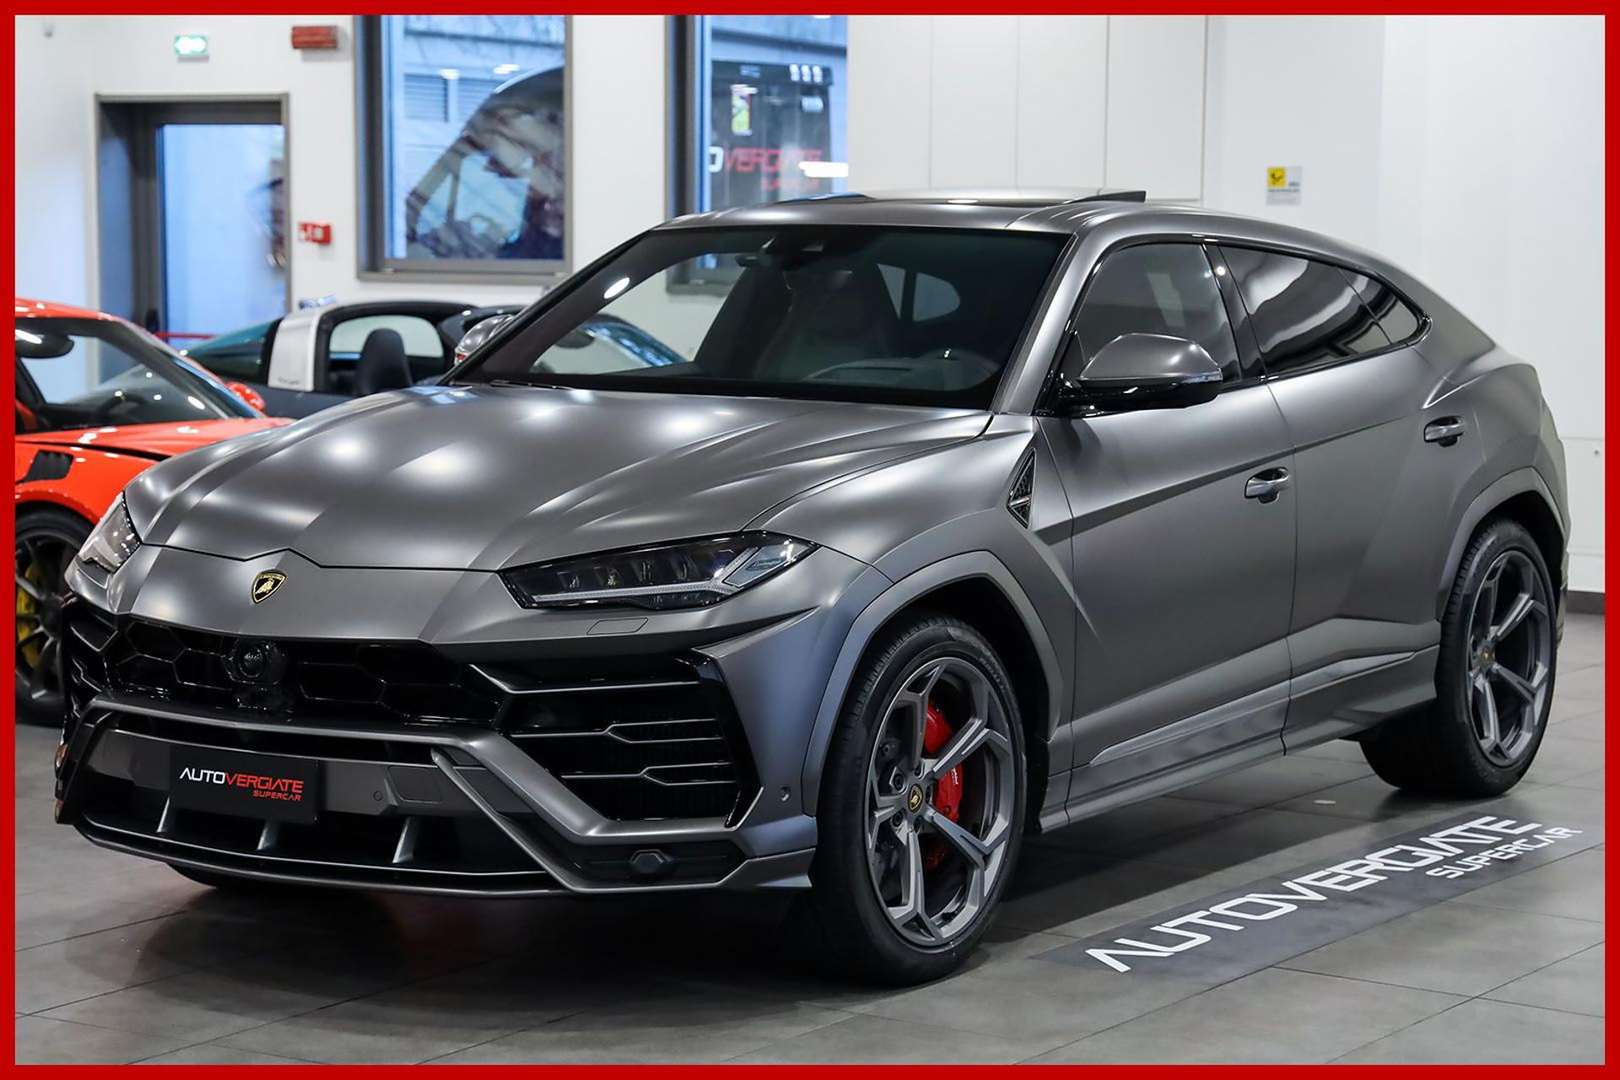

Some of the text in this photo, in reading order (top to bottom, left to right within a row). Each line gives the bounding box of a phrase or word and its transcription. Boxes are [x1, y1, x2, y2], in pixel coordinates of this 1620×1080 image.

[179, 767, 305, 793] AUTOVERGIATE
[252, 789, 303, 801] SUPERCAR
[1425, 826, 1583, 880] SUPERCAR
[1085, 815, 1543, 974] AUTOVERGIATE
